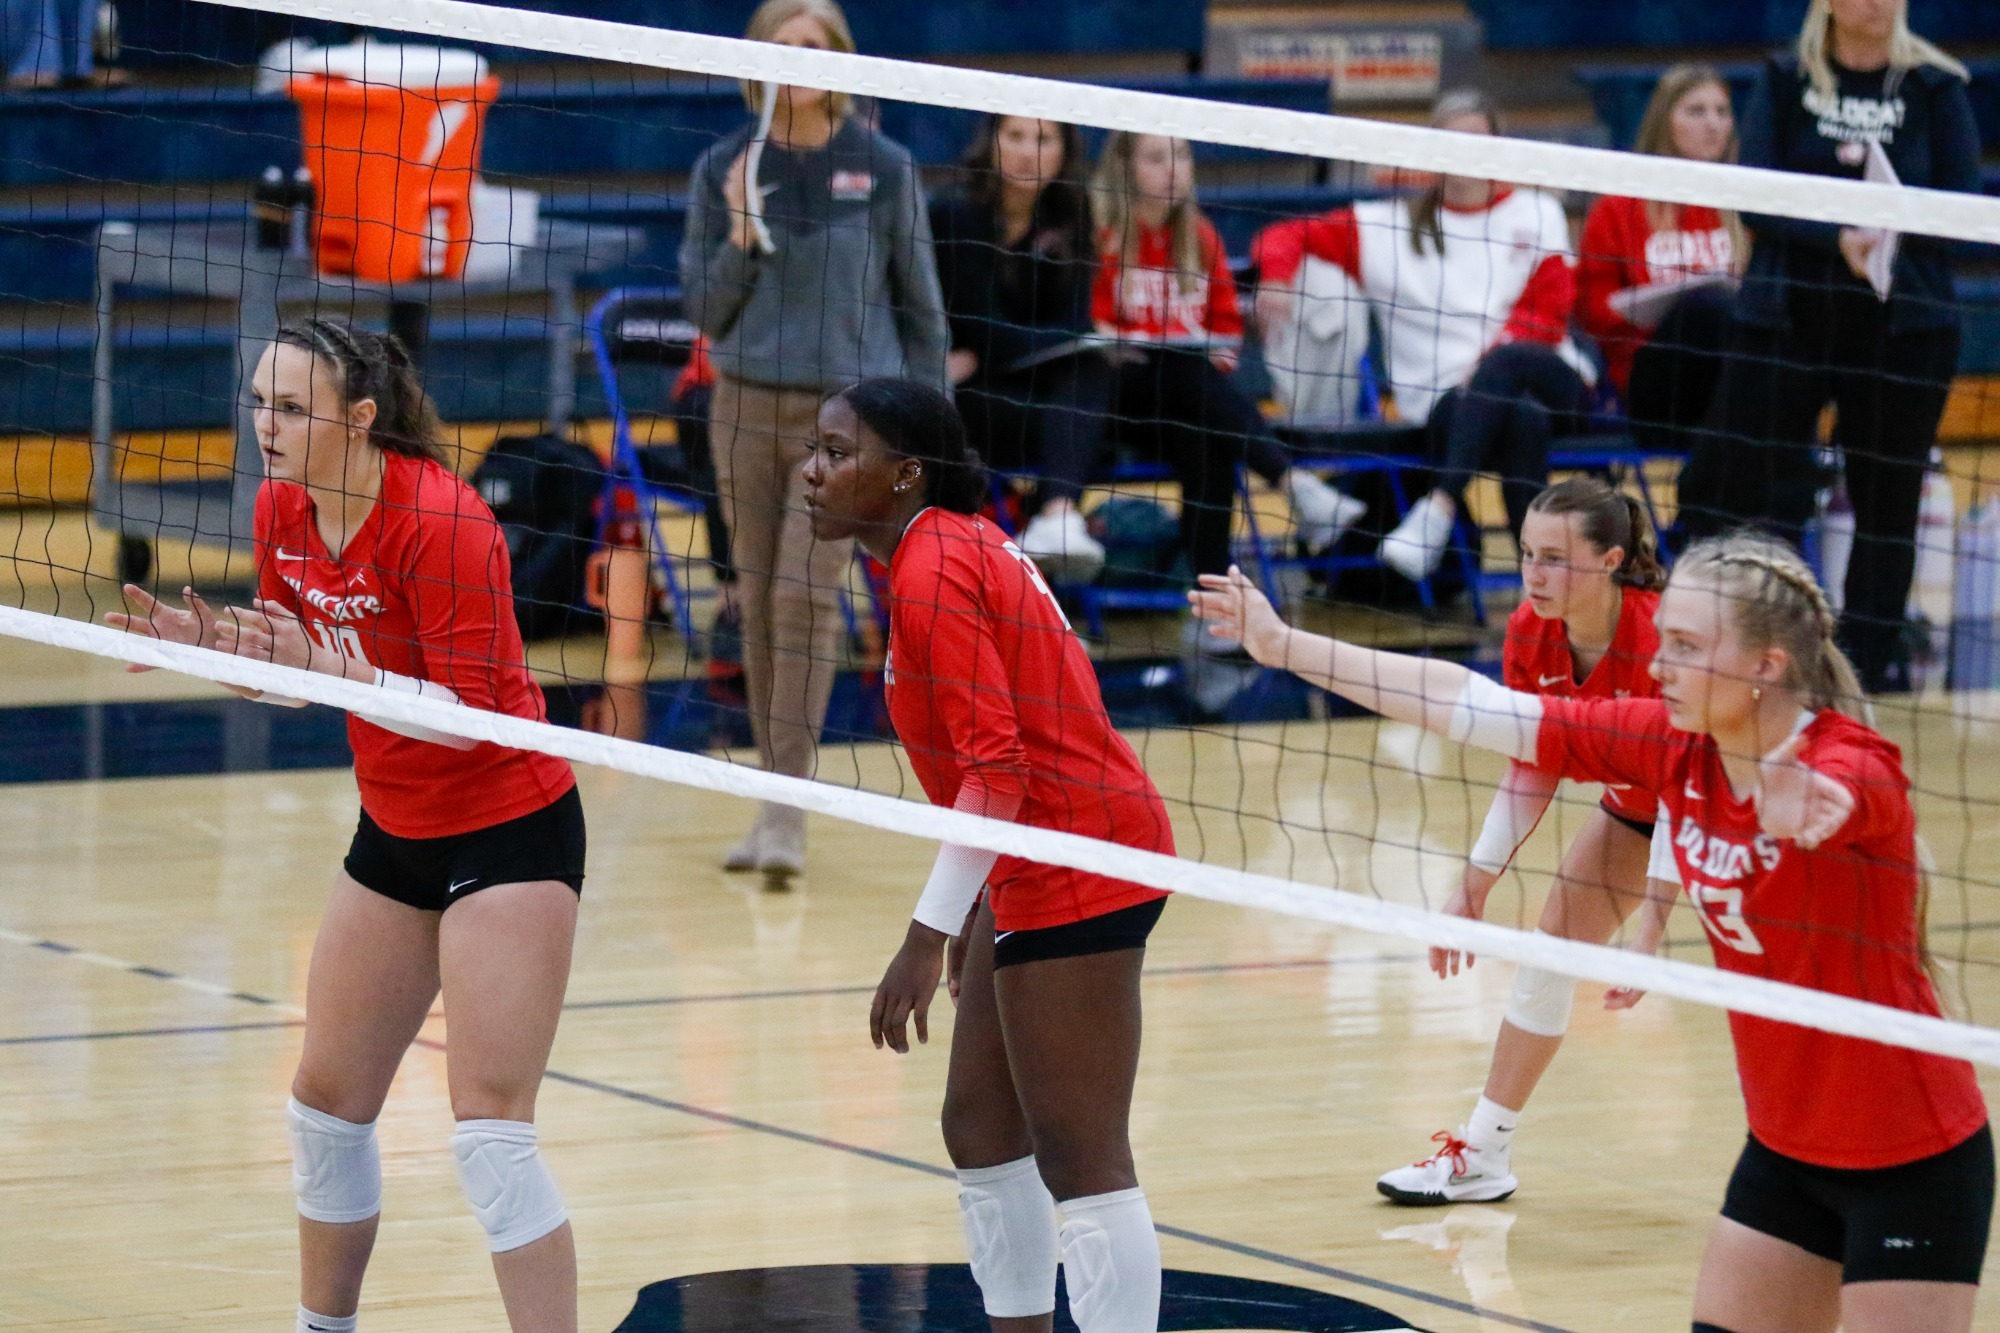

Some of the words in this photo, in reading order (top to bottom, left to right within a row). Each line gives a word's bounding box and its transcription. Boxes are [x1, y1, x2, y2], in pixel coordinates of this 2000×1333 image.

[1802, 89, 1905, 129] WLDCAT
[282, 575, 387, 622] ILDCATS
[313, 618, 373, 668] 10
[1689, 879, 1765, 955] 13
